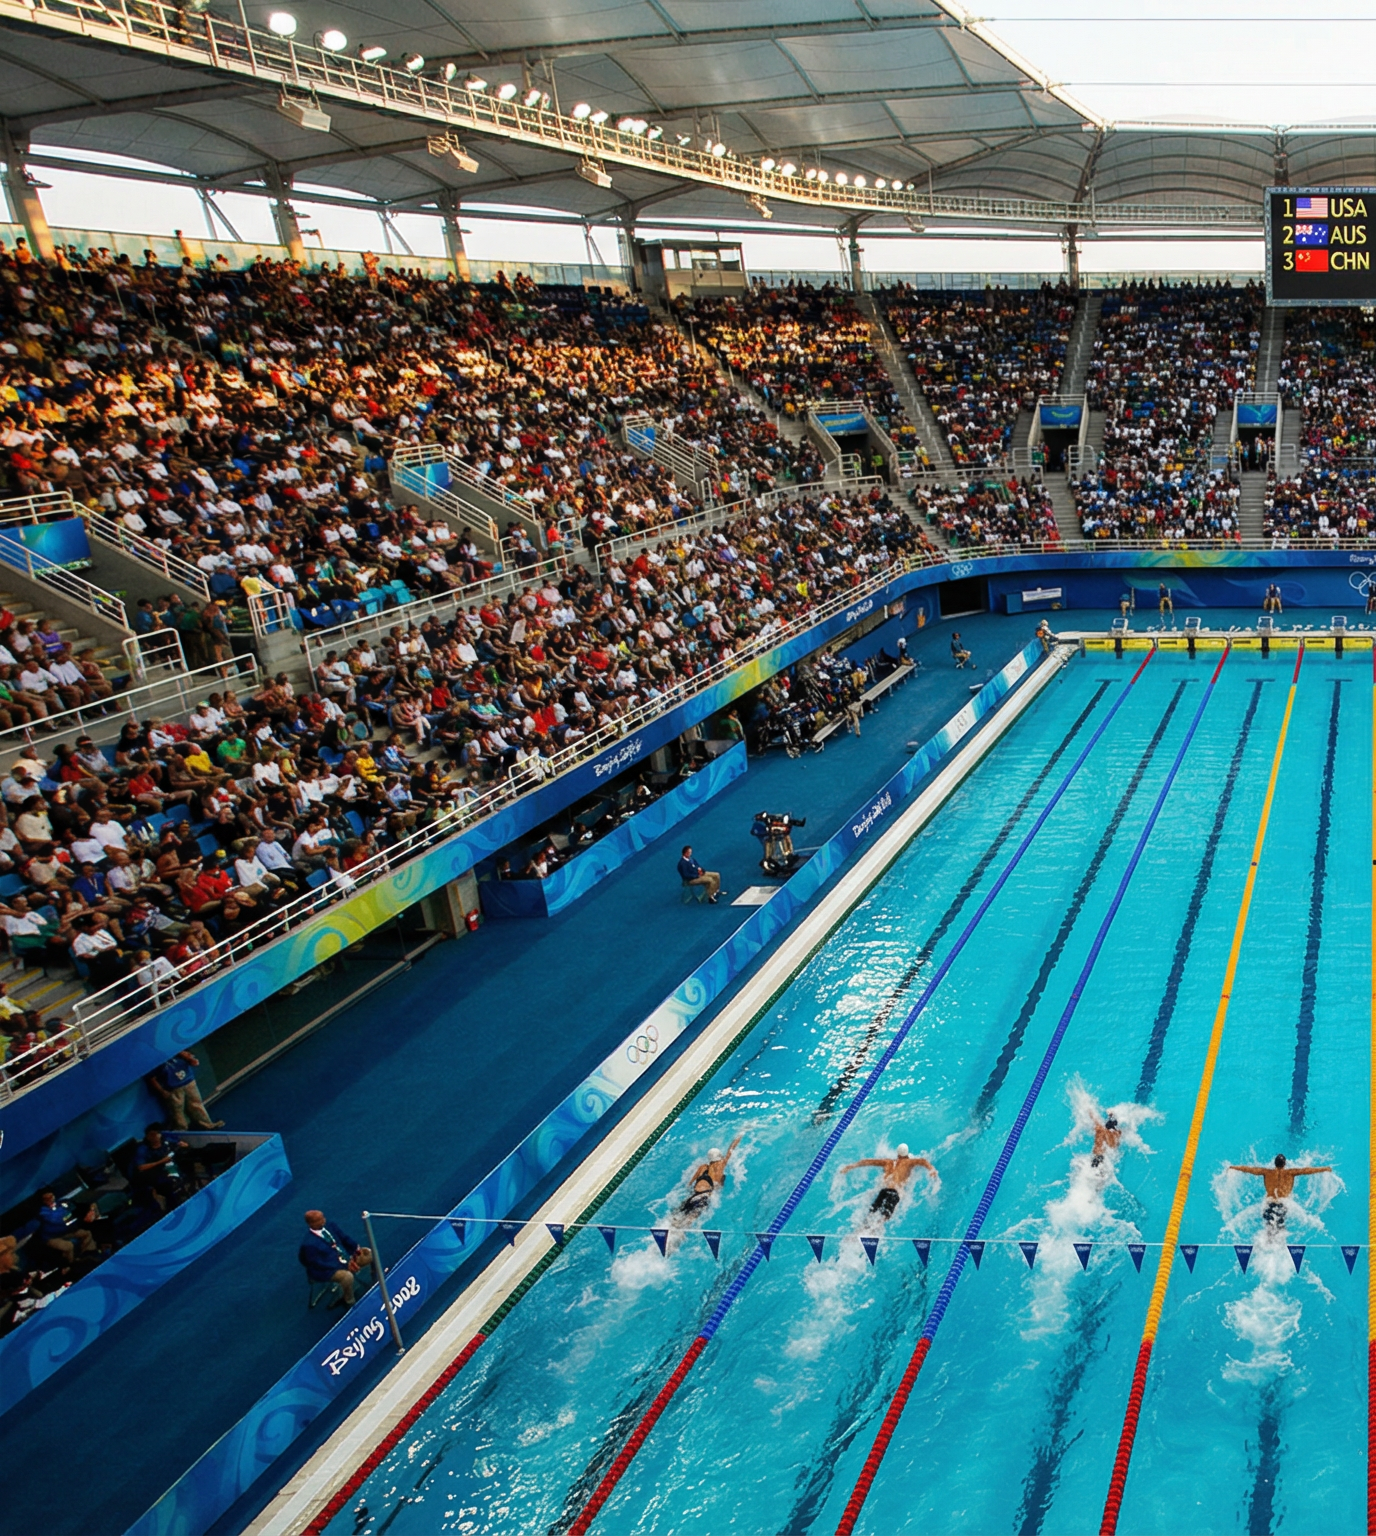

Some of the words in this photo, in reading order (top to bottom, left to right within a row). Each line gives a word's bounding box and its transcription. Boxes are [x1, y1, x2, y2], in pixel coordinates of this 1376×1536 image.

[1284, 199, 1293, 217] 1
[1331, 198, 1367, 217] USA
[1283, 226, 1293, 244] 2
[1330, 225, 1366, 244] AUS
[1284, 252, 1293, 270] 3
[1331, 252, 1369, 270] CHN
[321, 1316, 385, 1375] Beijing
